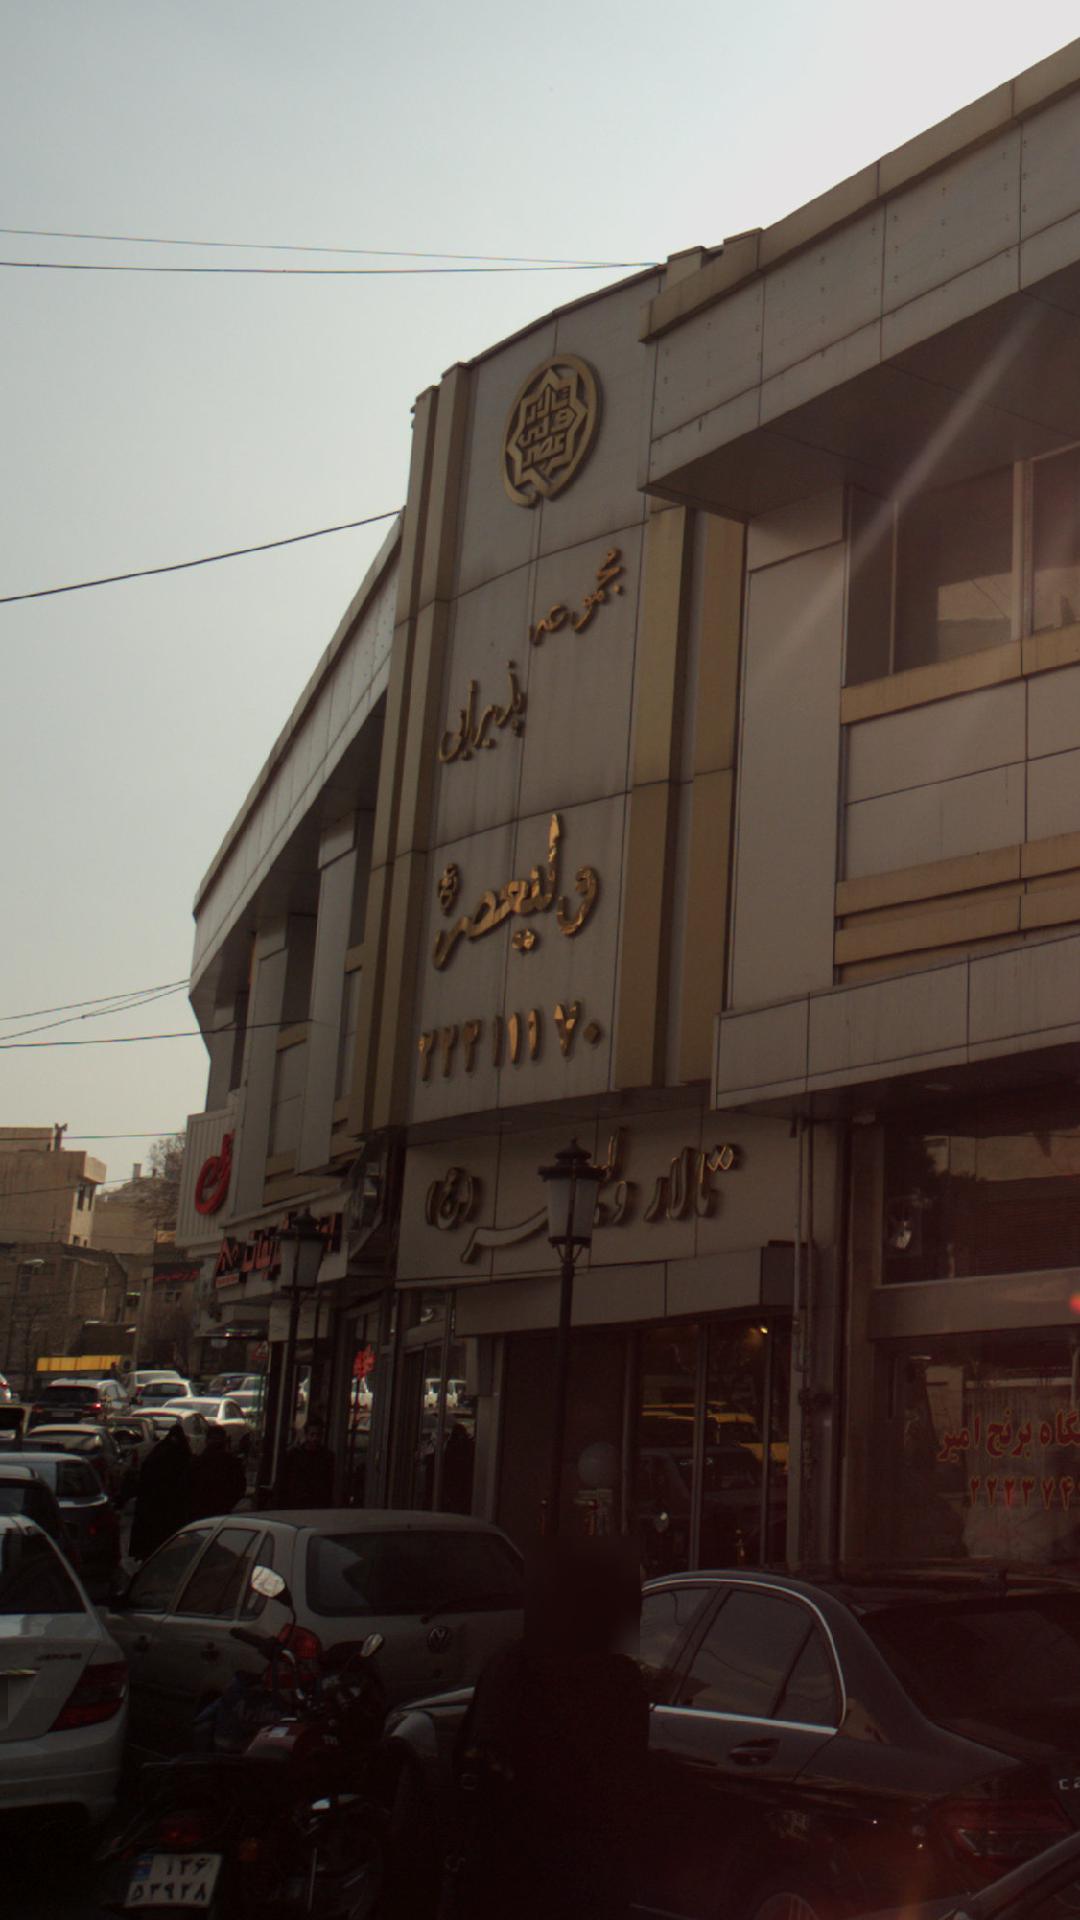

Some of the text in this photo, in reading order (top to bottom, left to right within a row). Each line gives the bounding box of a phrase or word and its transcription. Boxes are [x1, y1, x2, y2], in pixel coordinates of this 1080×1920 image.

[532, 548, 624, 645] مجموعه
[644, 1143, 735, 1220] تالار
[987, 1409, 1032, 1457] برنج
